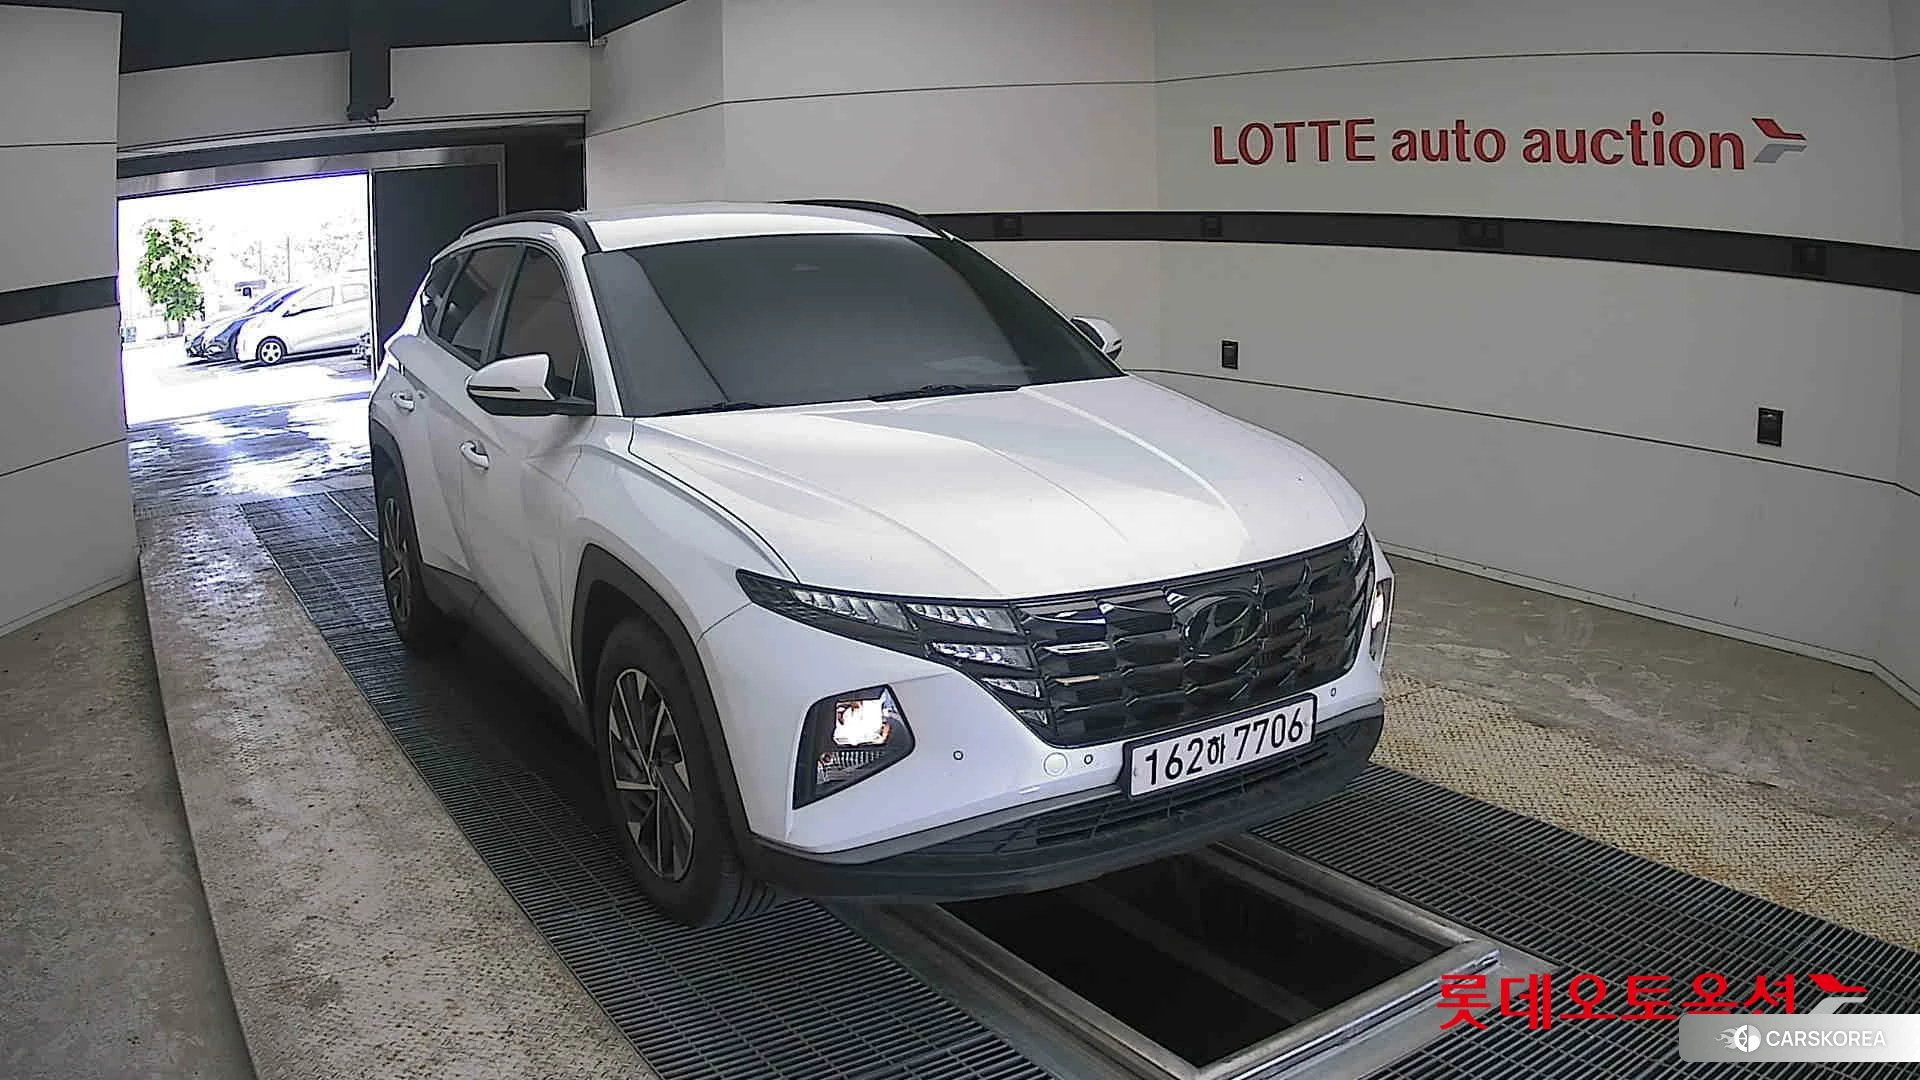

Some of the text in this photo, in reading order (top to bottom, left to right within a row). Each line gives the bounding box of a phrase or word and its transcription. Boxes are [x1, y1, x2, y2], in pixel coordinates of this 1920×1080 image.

[1214, 112, 1745, 170] LOTTE auto auction
[1145, 708, 1304, 786] 162하 7706
